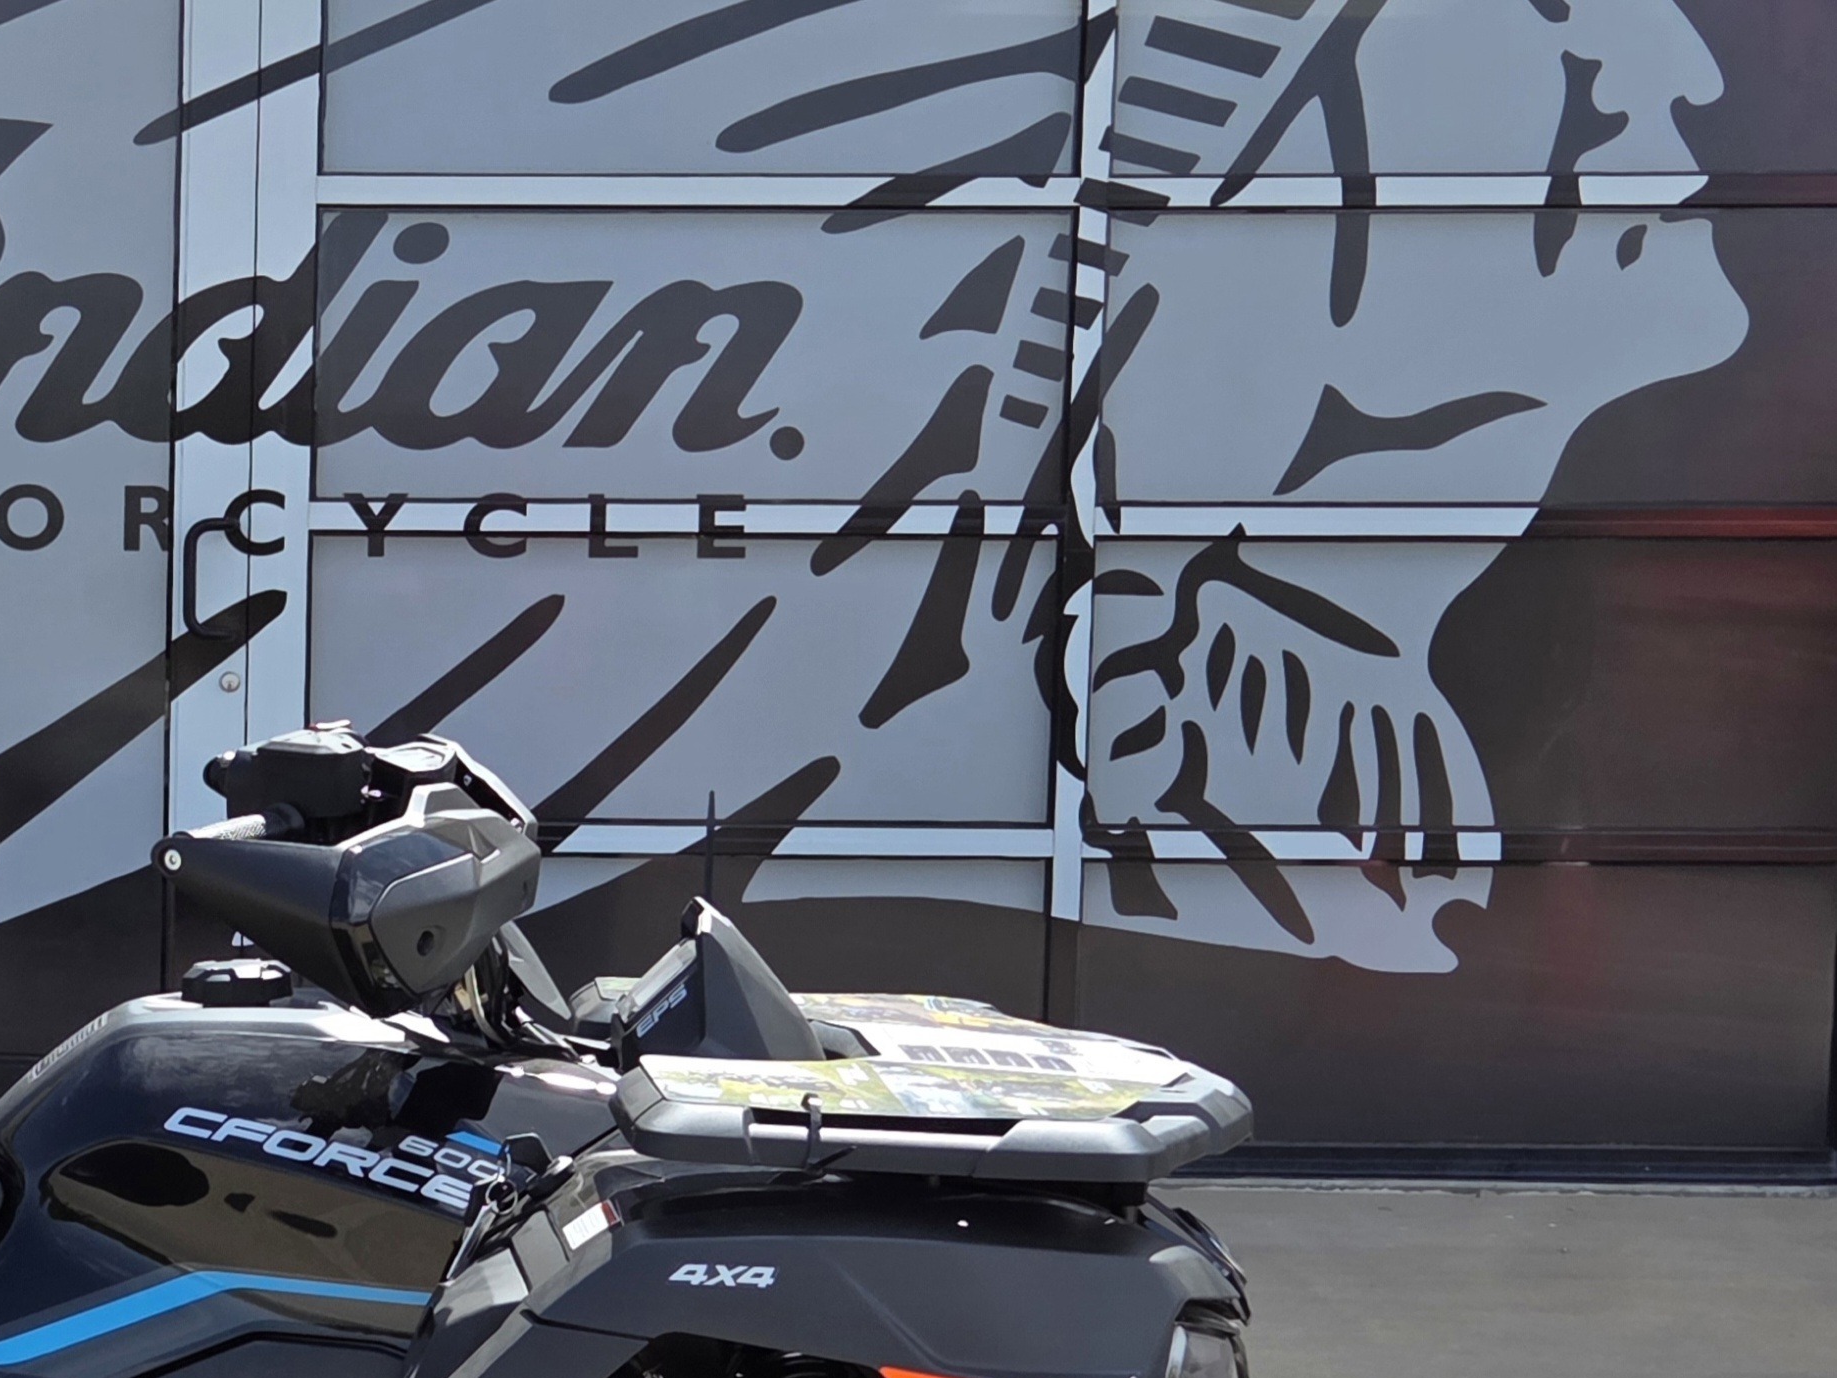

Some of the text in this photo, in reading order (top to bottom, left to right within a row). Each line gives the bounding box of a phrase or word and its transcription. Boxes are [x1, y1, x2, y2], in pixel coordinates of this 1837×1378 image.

[636, 984, 688, 1038] EPS
[163, 1107, 473, 1209] CFORCE
[398, 1135, 506, 1183] 600
